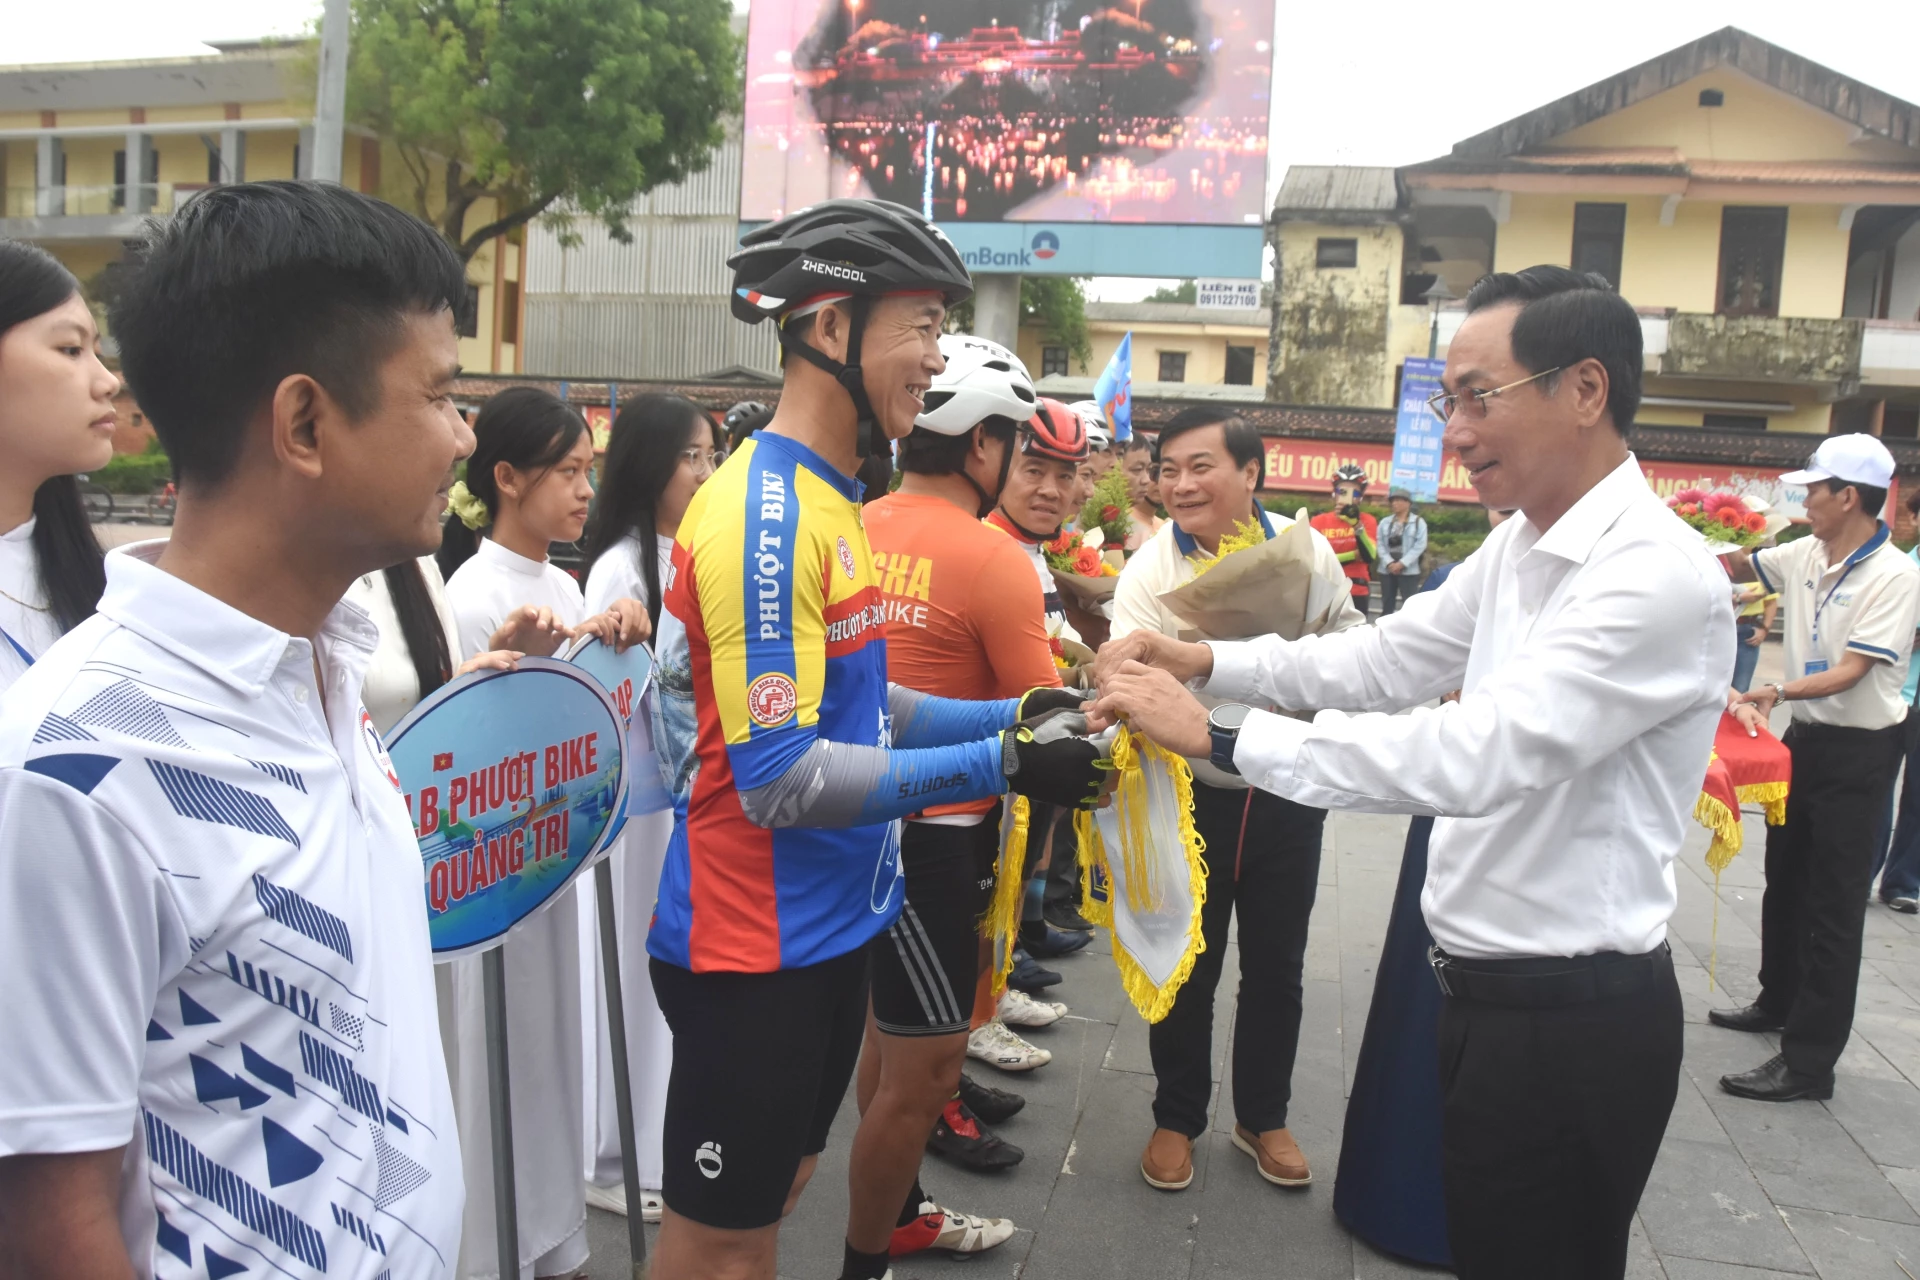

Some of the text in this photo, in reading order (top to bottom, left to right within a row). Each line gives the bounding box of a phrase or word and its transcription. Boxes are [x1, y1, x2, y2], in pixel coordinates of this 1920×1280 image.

[802, 259, 867, 283] ZHENCOOL
[1200, 293, 1257, 306] 0911227100
[1202, 282, 1233, 292] LIÊN
[754, 470, 785, 642] PHƯỢT BIKE
[883, 599, 929, 628] IKE
[448, 749, 538, 828] PHƯỢT
[544, 731, 599, 791] BIKE
[897, 772, 968, 800] SPORTS
[429, 809, 570, 914] QUẢNG TRỊ
